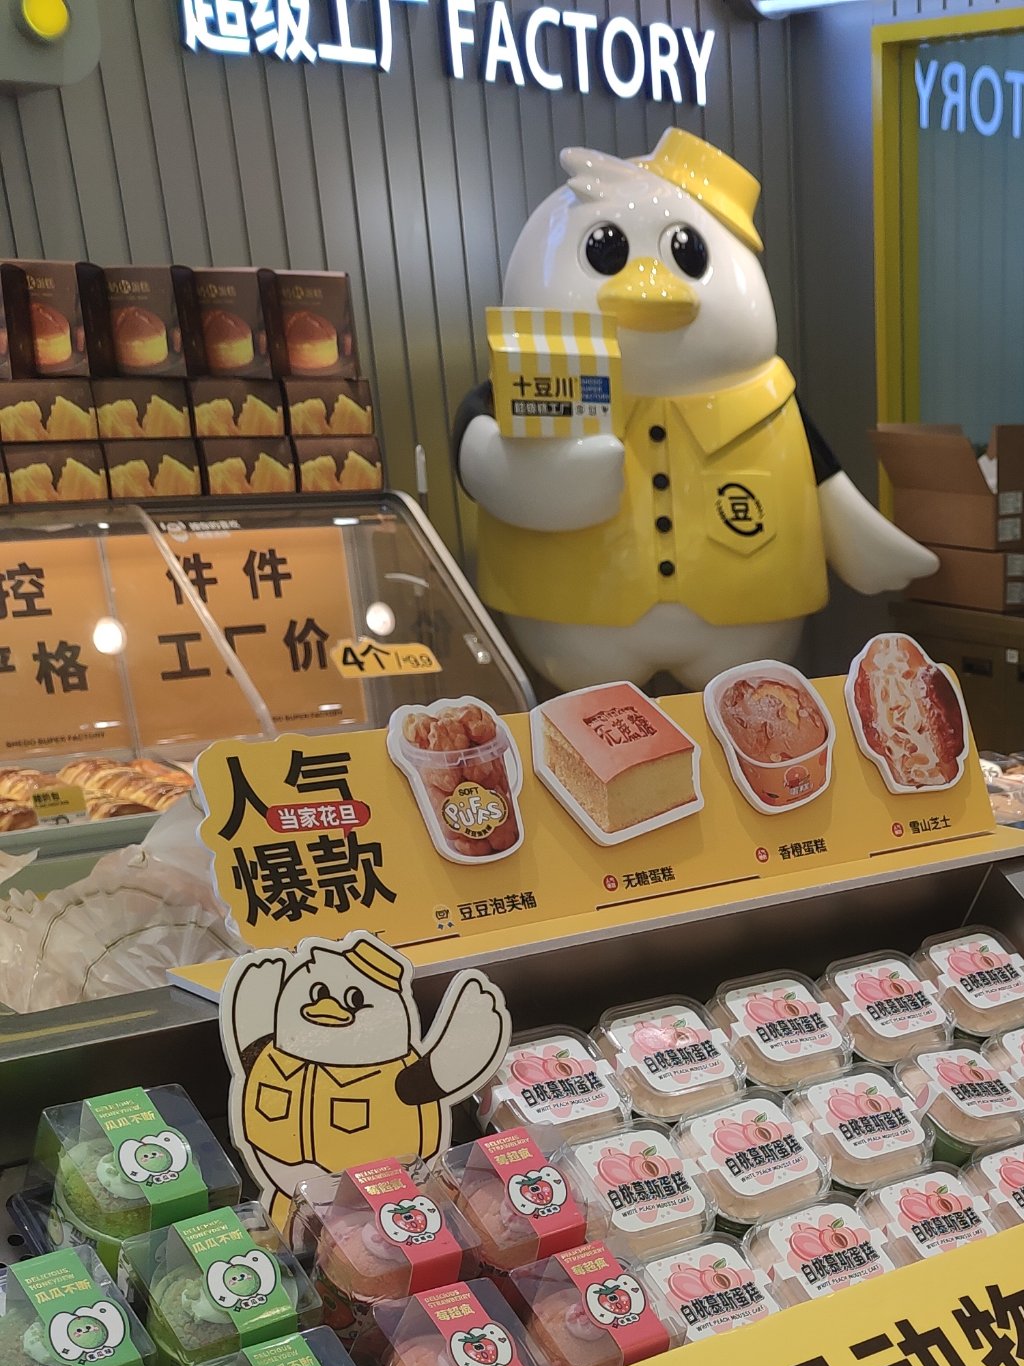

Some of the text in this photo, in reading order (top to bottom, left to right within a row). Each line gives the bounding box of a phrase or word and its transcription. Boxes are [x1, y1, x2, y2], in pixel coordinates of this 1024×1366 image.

[447, 0, 716, 106] FACTORY
[513, 375, 573, 398] 十豆川
[728, 496, 752, 521] 豆
[158, 617, 332, 682] 工厂价
[342, 644, 391, 672] 4个
[218, 750, 355, 841] 人气
[458, 787, 479, 797] SOFT
[277, 805, 361, 831] 当家花旦
[444, 796, 502, 829] PUFFS
[909, 816, 952, 835] 雪山芝士
[778, 838, 828, 861] 香橙蛋糕
[231, 833, 397, 927] 爆款
[623, 866, 676, 890] 无糖蛋糕
[457, 891, 537, 921] 豆豆泡芙桶
[755, 1013, 829, 1044] 白桃慕斯蛋糕
[643, 1039, 720, 1074] 白桃慕斯蛋糕
[521, 1070, 604, 1107] 白桃慕斯蛋糕
[105, 1111, 155, 1132] 瓜瓜不断
[838, 1108, 912, 1142] 白桃慕斯蛋糕
[725, 1135, 803, 1177] 白桃慕斯蛋糕
[607, 1172, 692, 1211] 白桃慕斯蛋糕
[193, 1231, 244, 1254] 瓜瓜不断
[910, 1207, 982, 1246] 白桃慕斯蛋糕
[801, 1241, 881, 1284] 白桃慕斯蛋糕
[35, 1281, 91, 1305] 瓜瓜不断
[680, 1282, 765, 1326] 白桃慕斯蛋糕
